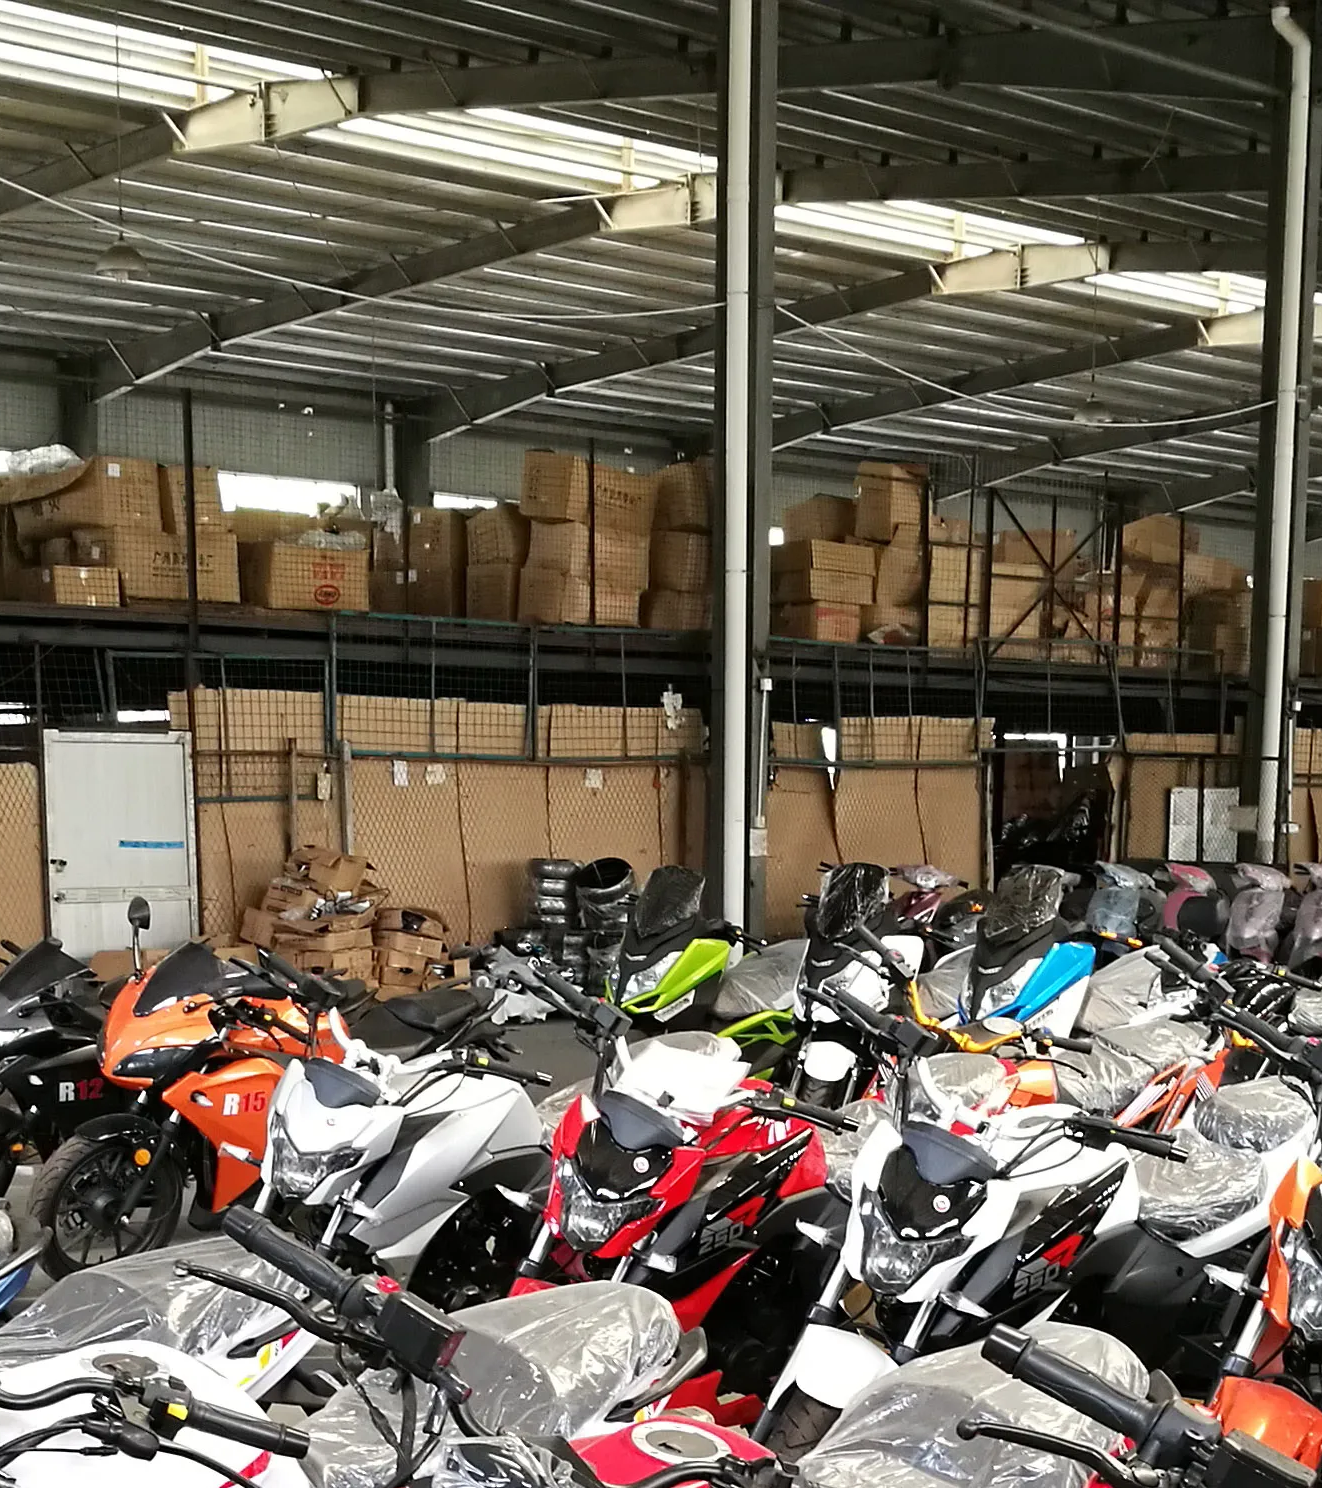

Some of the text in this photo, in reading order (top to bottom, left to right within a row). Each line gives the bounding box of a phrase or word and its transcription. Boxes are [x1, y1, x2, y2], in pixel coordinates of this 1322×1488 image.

[58, 1078, 105, 1103] R12
[222, 1091, 267, 1116] R15
[698, 1219, 745, 1256] 250
[1012, 1260, 1061, 1300] 250
